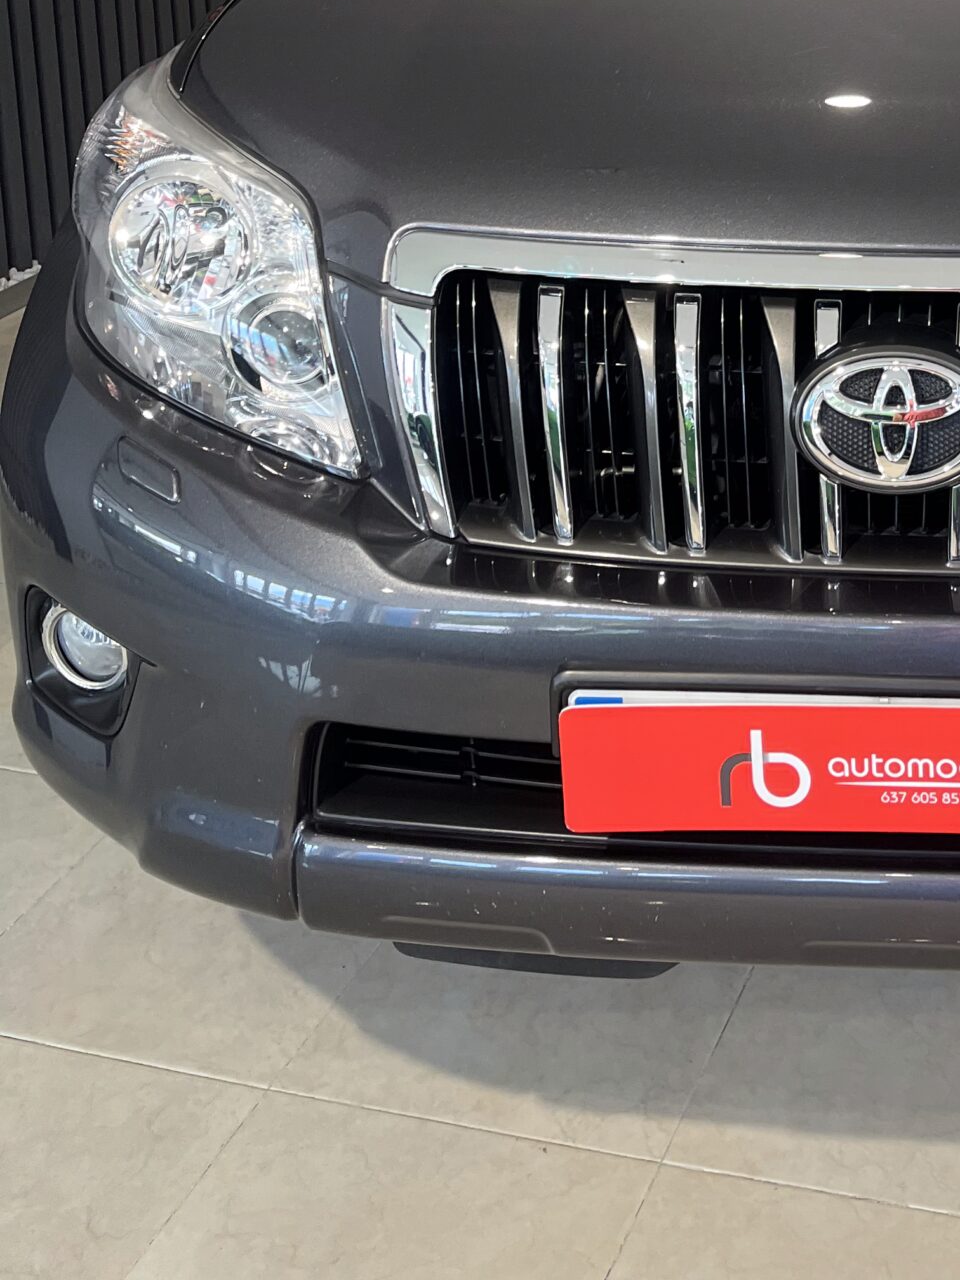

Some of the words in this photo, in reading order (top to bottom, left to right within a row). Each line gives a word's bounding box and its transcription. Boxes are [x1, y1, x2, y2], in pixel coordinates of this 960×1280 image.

[719, 729, 811, 808] rb
[880, 791, 906, 804] 637
[911, 791, 938, 805] 605
